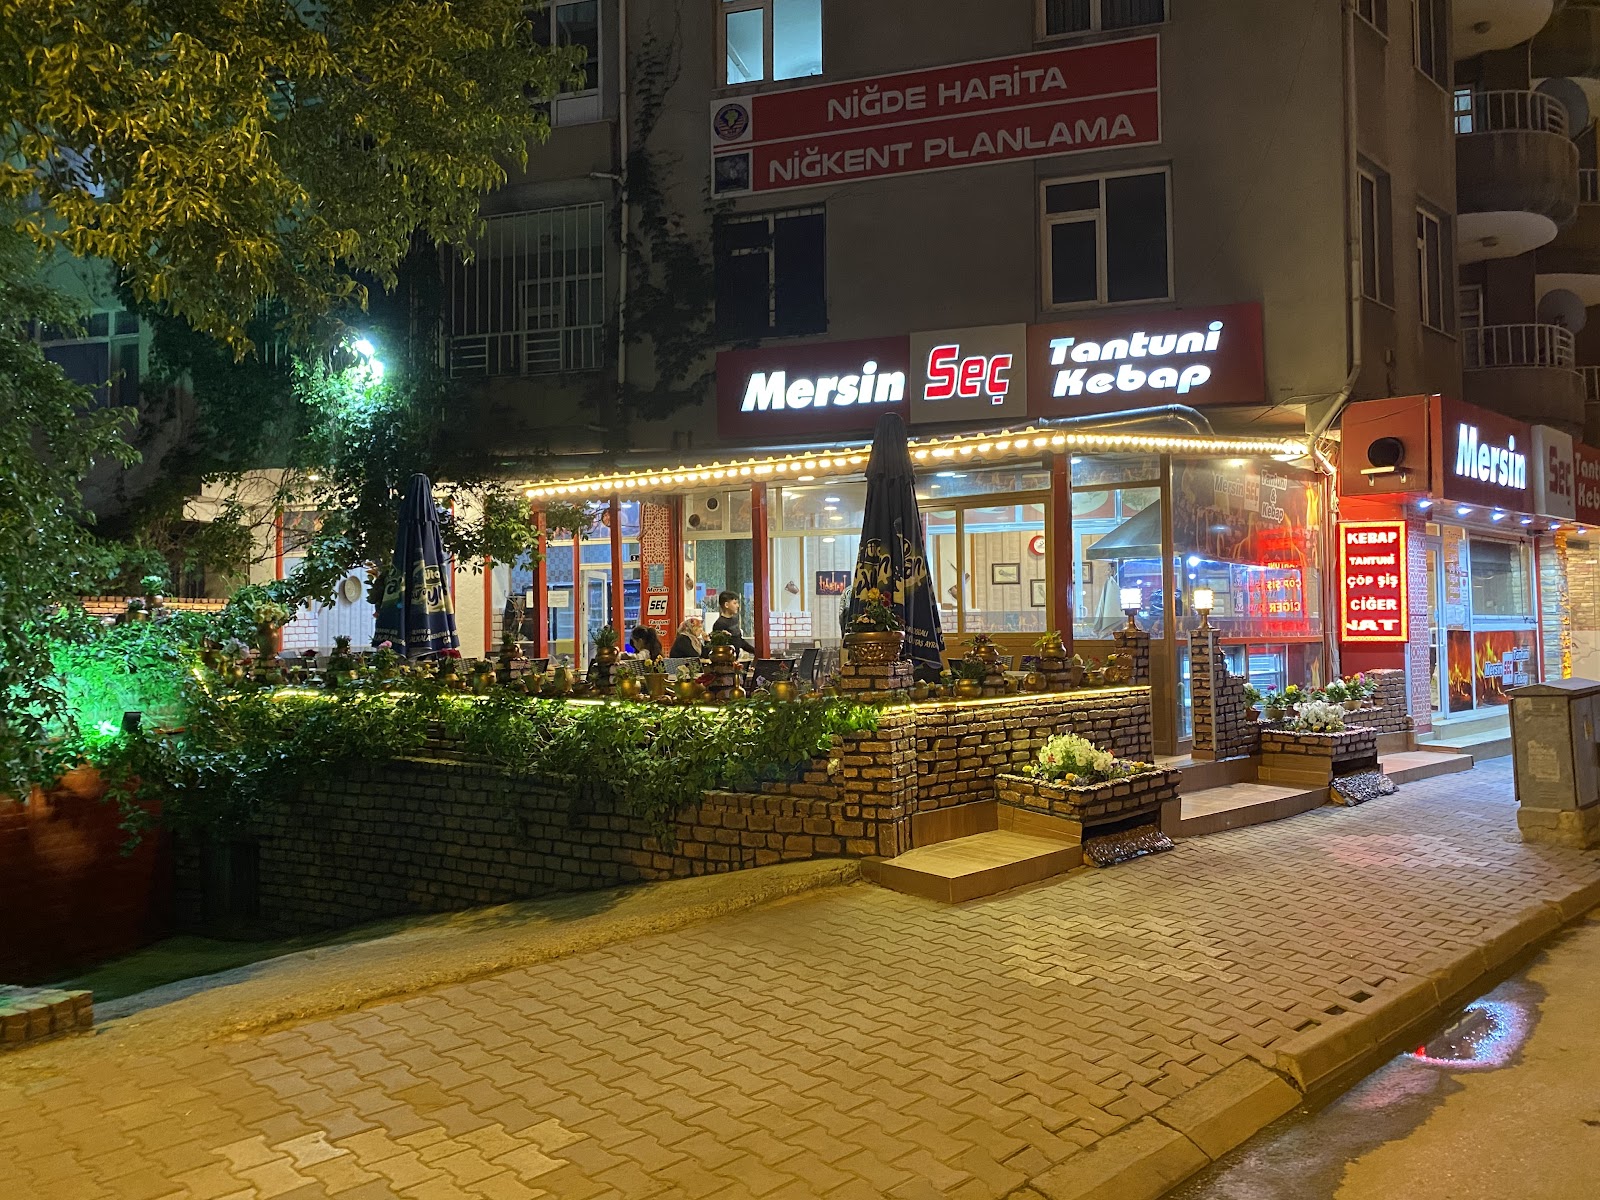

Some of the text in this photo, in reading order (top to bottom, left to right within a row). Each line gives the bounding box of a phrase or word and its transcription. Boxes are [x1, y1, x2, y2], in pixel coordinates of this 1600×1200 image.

[827, 65, 1067, 122] NİĞDE HARİTA
[769, 114, 1136, 183] NİĞKENT PLANLAMA
[1049, 320, 1224, 365] Tantuni
[741, 361, 907, 412] Mersin
[923, 344, 1013, 406] Seç
[1053, 362, 1211, 398] Kebap
[1455, 423, 1527, 490] Mersin
[1214, 473, 1245, 498] Mersin
[1261, 501, 1285, 523] Kebap
[1347, 532, 1397, 544] KEBAP
[1349, 553, 1395, 565] TANTUNİ
[1347, 573, 1398, 588] ÇÖP ŞİŞ
[1350, 597, 1397, 610] CİĞER
